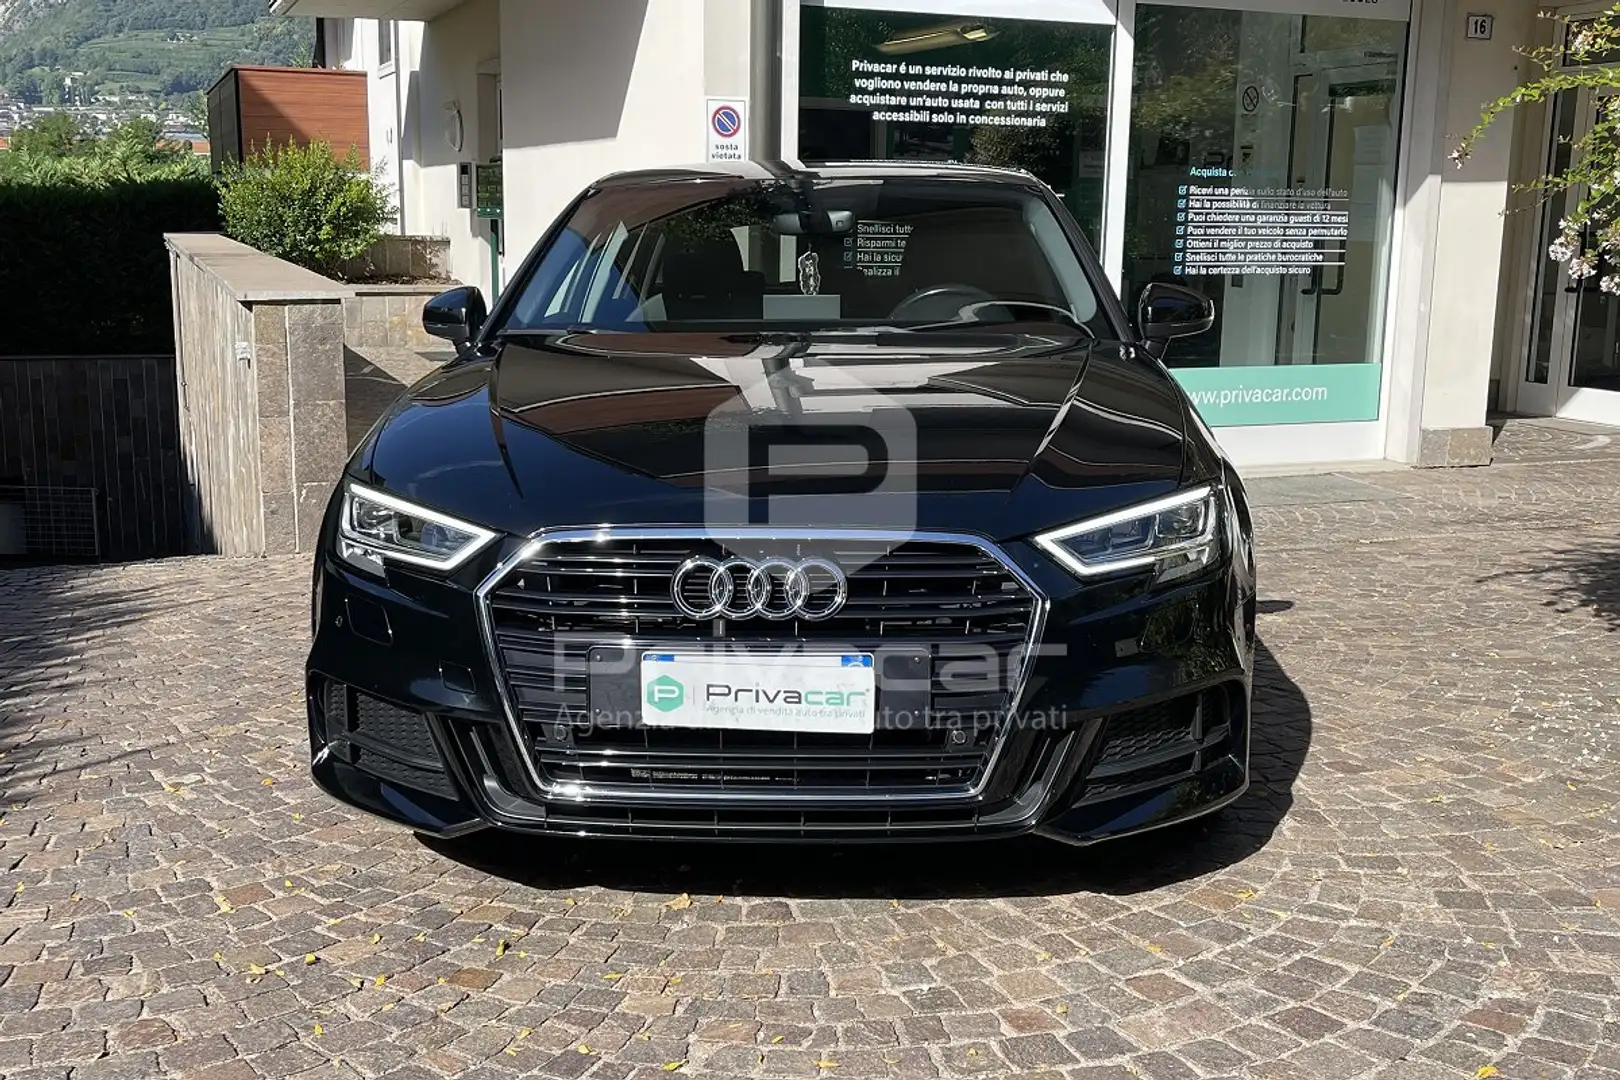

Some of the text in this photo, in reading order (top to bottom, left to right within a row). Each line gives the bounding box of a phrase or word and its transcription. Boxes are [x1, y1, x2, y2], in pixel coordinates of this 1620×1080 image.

[1473, 19, 1487, 34] 16
[852, 60, 897, 73] Privacar
[909, 65, 923, 75] un
[925, 64, 966, 77] servizio
[968, 66, 1002, 79] rivolto
[1004, 68, 1013, 79] ai
[1016, 68, 1048, 83] privati
[1050, 70, 1068, 82] che
[855, 77, 1065, 99] vogliono vendere la propria auto, oppure
[850, 93, 906, 107] acquistare
[910, 95, 948, 107] un'auto
[952, 97, 980, 108] usata
[985, 101, 1003, 109] con
[1007, 99, 1028, 110] tutti
[1035, 101, 1068, 112] servizi
[873, 110, 1046, 127] accessibili solo in concessionaria
[711, 152, 741, 160] vietata
[1190, 167, 1227, 178] Acquista
[1190, 185, 1213, 195] Ricevi
[1215, 187, 1228, 195] una
[1276, 188, 1294, 196] stato
[1189, 200, 1202, 208] Hai
[1204, 200, 1210, 208] la
[1252, 201, 1259, 209] di
[1188, 213, 1205, 222] Puoi
[1207, 213, 1239, 222] chiedere
[1257, 214, 1287, 224] garanzia
[1290, 214, 1311, 224] guasti
[1313, 214, 1320, 222] di
[1322, 214, 1330, 222] 12
[1331, 214, 1348, 223] mesi
[857, 224, 894, 233] Snellisci
[1187, 226, 1205, 235] Puoi
[1206, 227, 1236, 235] vendere
[1238, 227, 1242, 235] il
[1258, 227, 1284, 236] veicolo
[1285, 228, 1306, 236] senza
[1308, 228, 1348, 237] permutarlo
[857, 238, 896, 248] Risparmi
[1187, 239, 1313, 250] Ottieni il miglior prezzo di acquisto
[857, 252, 872, 262] Hai
[874, 252, 881, 262] la
[1186, 252, 1323, 263] Snellisci tutte le pratiche burocratiche
[857, 266, 892, 276] ealizza
[1185, 266, 1198, 275] Hai
[1200, 266, 1206, 275] la
[1208, 266, 1240, 275] certezza
[1288, 267, 1310, 275] sicuro
[706, 682, 867, 706] Privacar
[758, 706, 792, 716] vendita
[818, 708, 832, 717] tra
[835, 709, 866, 719] privati
